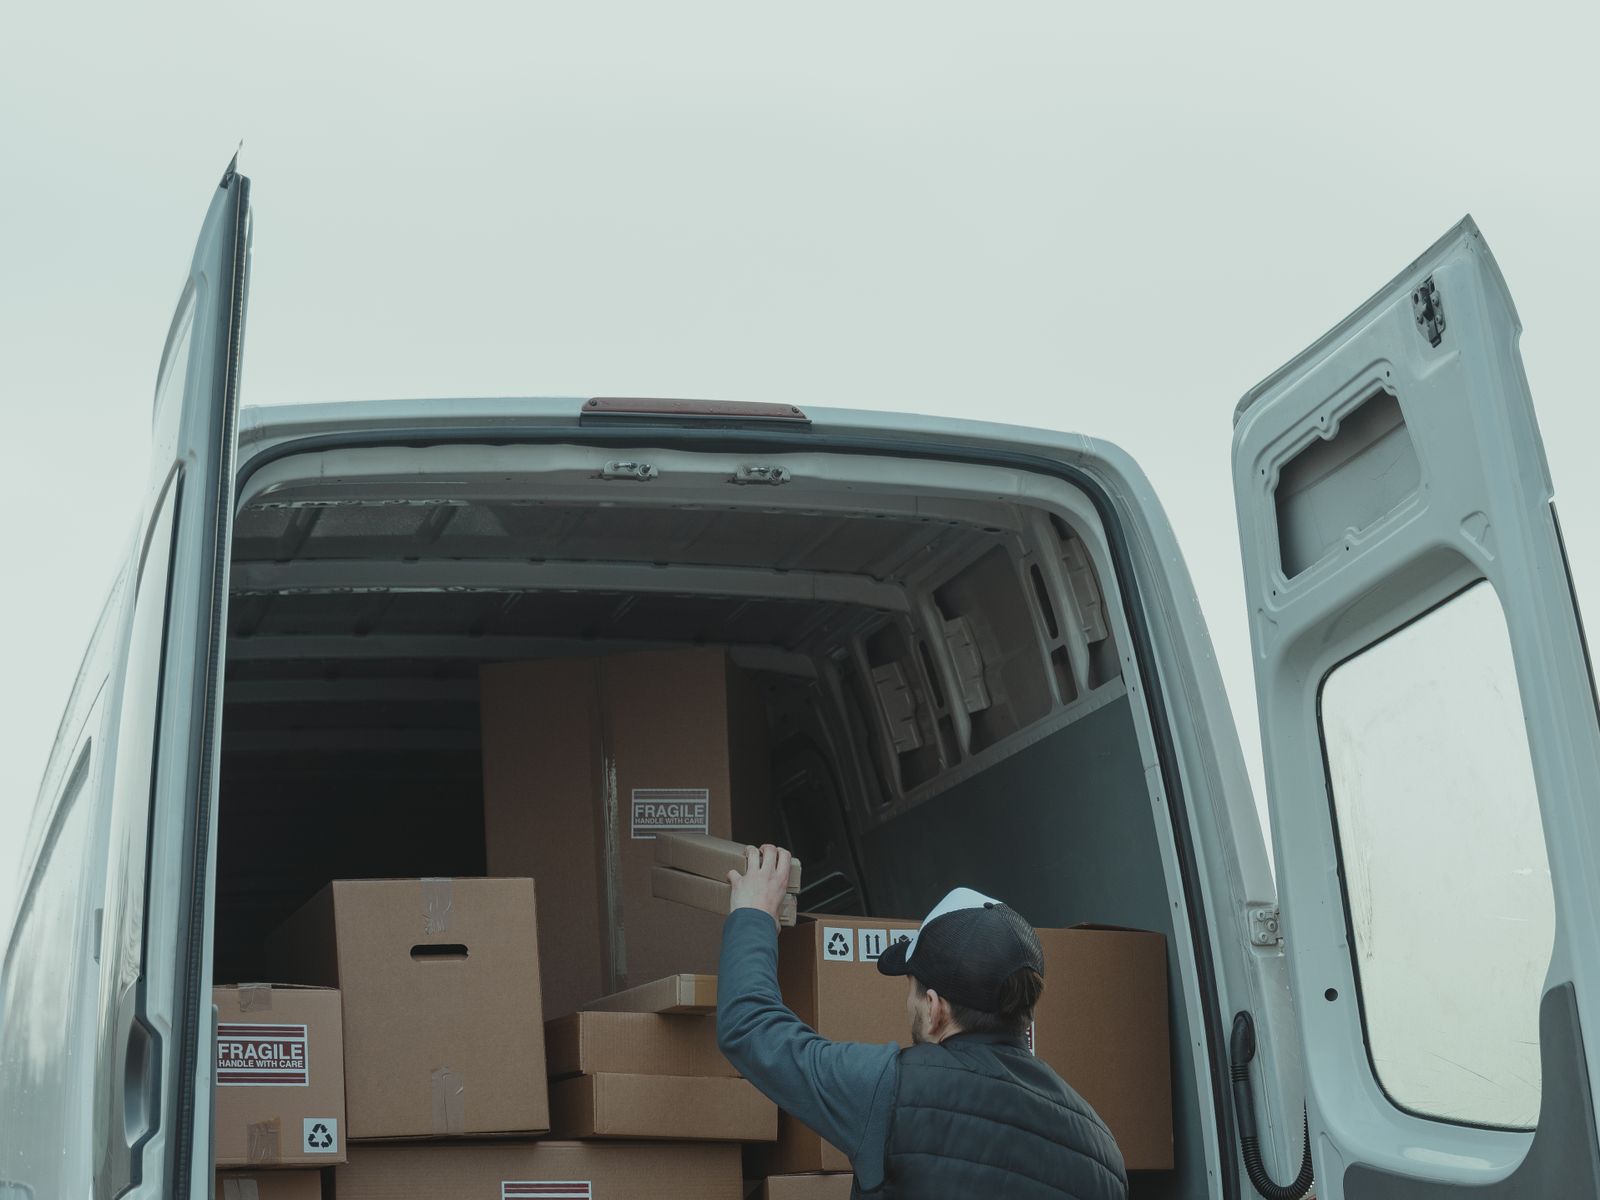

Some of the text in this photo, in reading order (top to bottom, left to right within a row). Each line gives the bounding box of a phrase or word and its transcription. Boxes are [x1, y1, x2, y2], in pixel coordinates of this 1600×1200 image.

[635, 804, 705, 818] FRAGILE
[635, 817, 704, 825] HANDLE WITH CARE
[218, 1043, 303, 1060] FRAGILE
[219, 1060, 303, 1068] HANDLE WITH CARE
